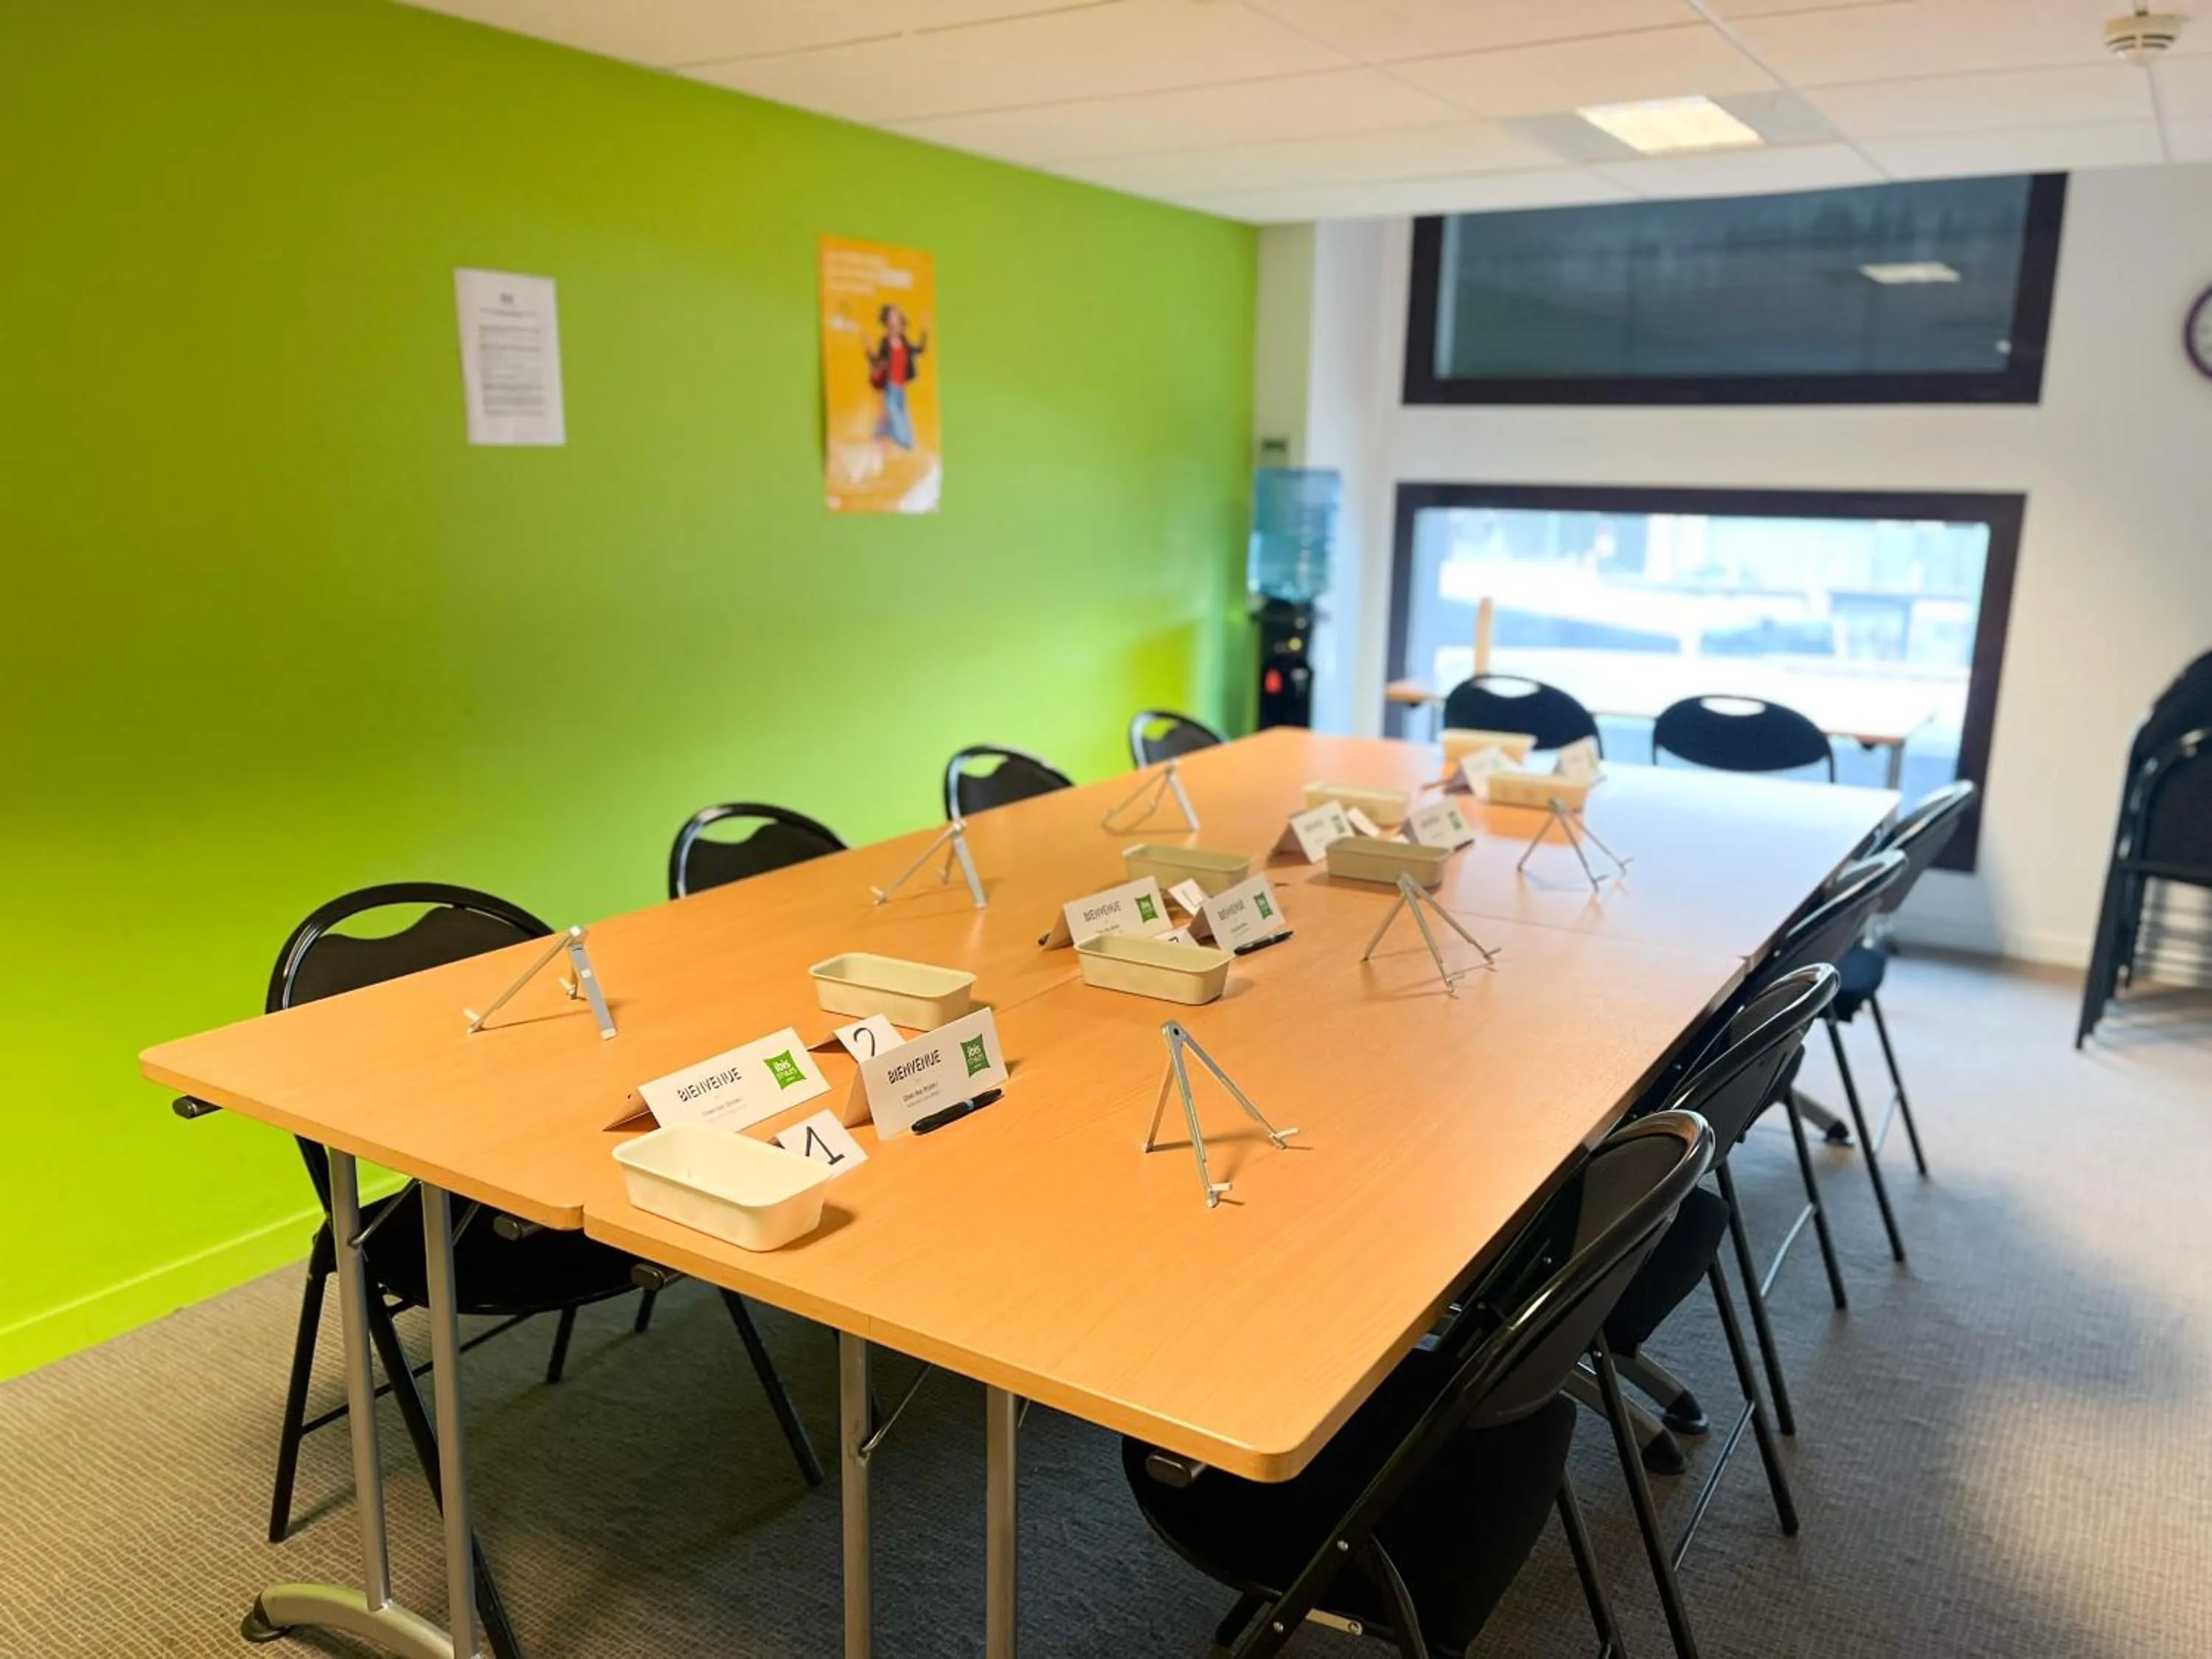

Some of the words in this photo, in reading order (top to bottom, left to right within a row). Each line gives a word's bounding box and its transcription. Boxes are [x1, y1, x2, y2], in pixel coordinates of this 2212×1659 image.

[887, 1049, 942, 1084] BIENVENUE
[677, 1067, 742, 1102] BIENVENUE
[805, 1126, 845, 1165] 1
